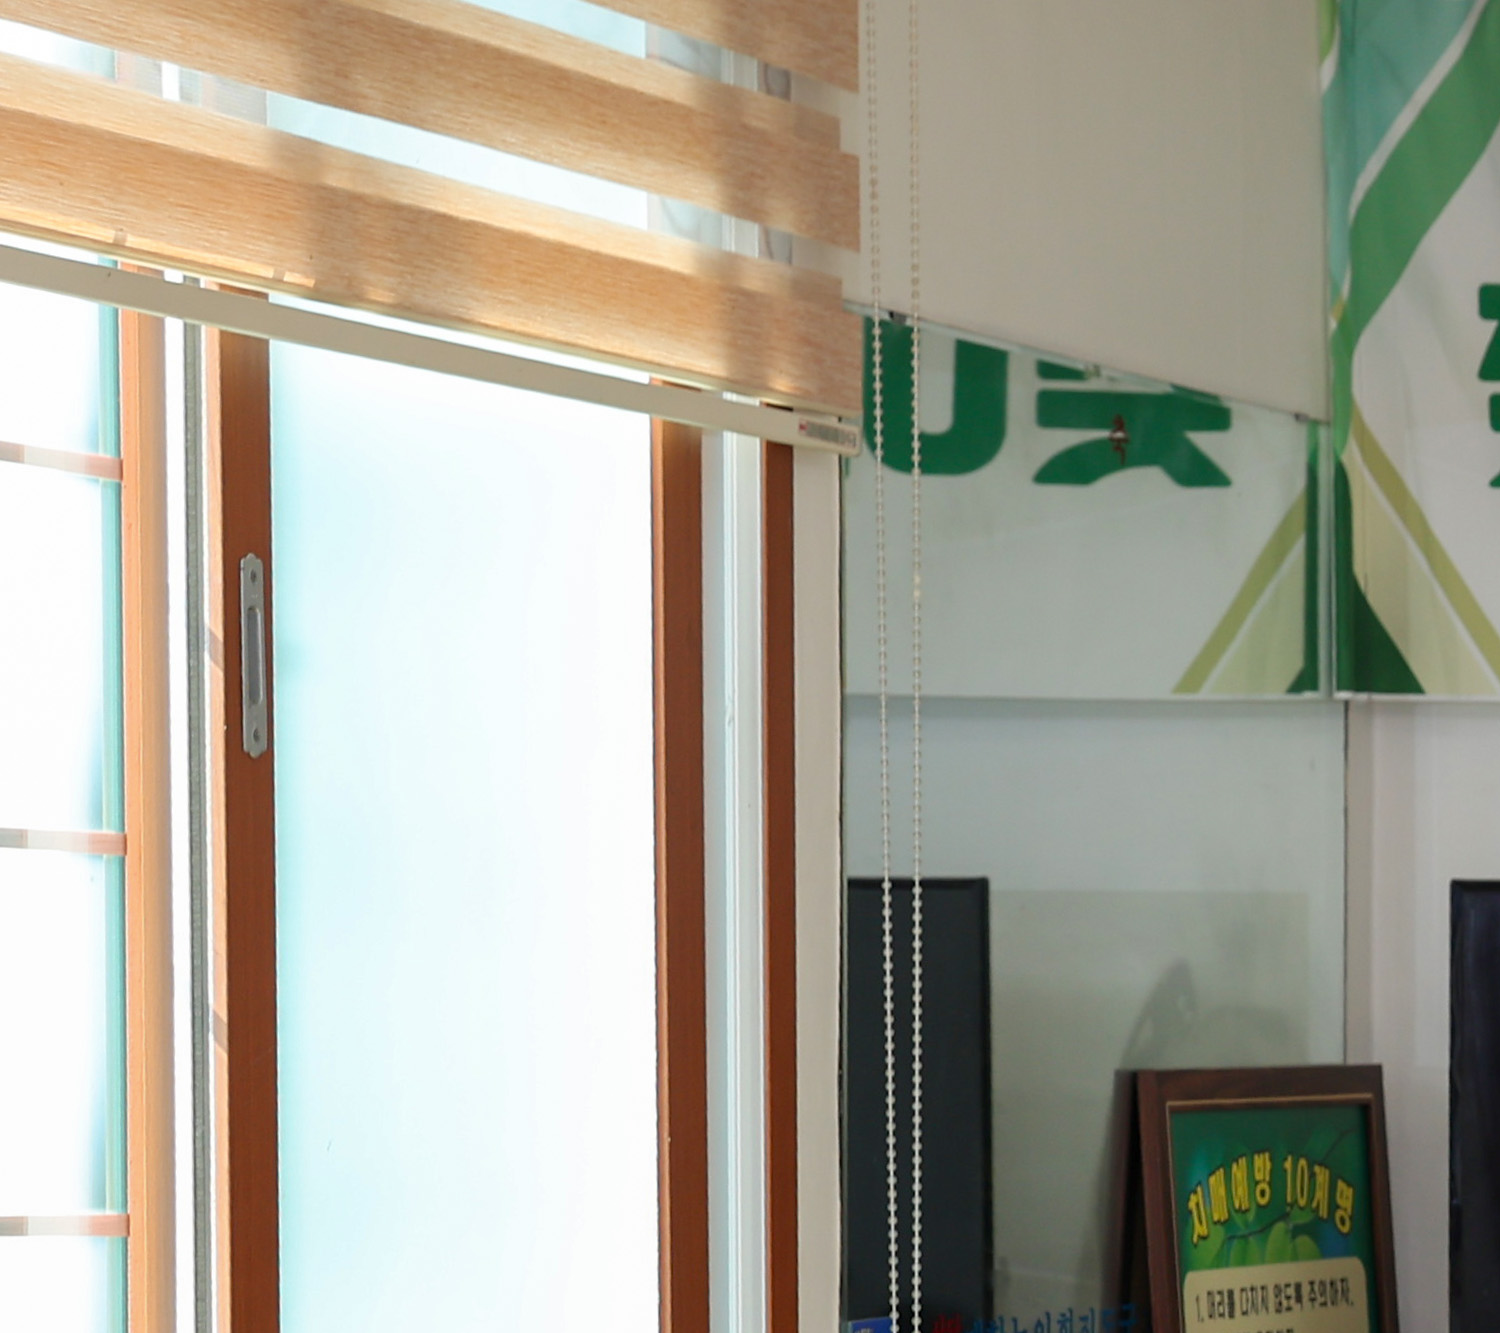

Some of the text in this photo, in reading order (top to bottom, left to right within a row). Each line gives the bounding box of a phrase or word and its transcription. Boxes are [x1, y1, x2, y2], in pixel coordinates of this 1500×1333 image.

[1187, 1151, 1355, 1244] 치매예방 10계명
[1207, 1289, 1236, 1320] 머리를
[1240, 1284, 1270, 1317] 다치지
[1273, 1281, 1304, 1314] 않도록
[1308, 1277, 1355, 1312] 주의하자.
